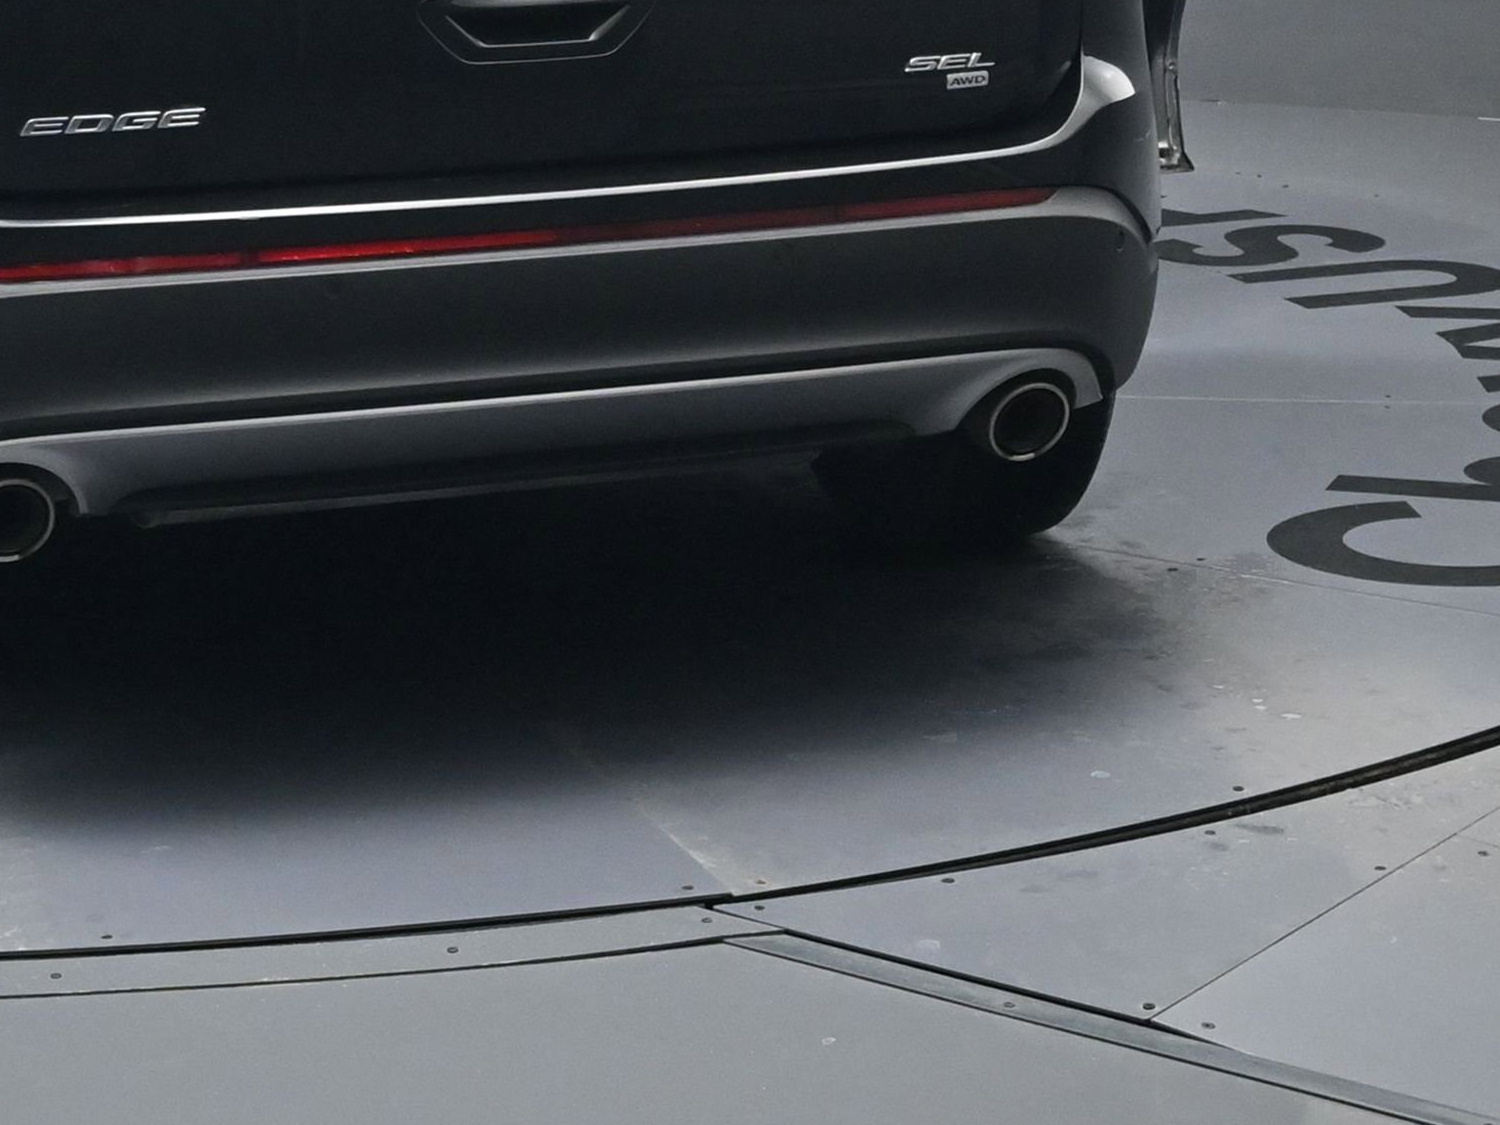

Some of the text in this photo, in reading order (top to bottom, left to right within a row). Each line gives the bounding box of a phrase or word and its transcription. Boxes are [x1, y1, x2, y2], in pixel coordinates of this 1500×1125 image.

[904, 52, 996, 72] SEL
[949, 75, 986, 87] AWD
[20, 107, 206, 137] EDGE
